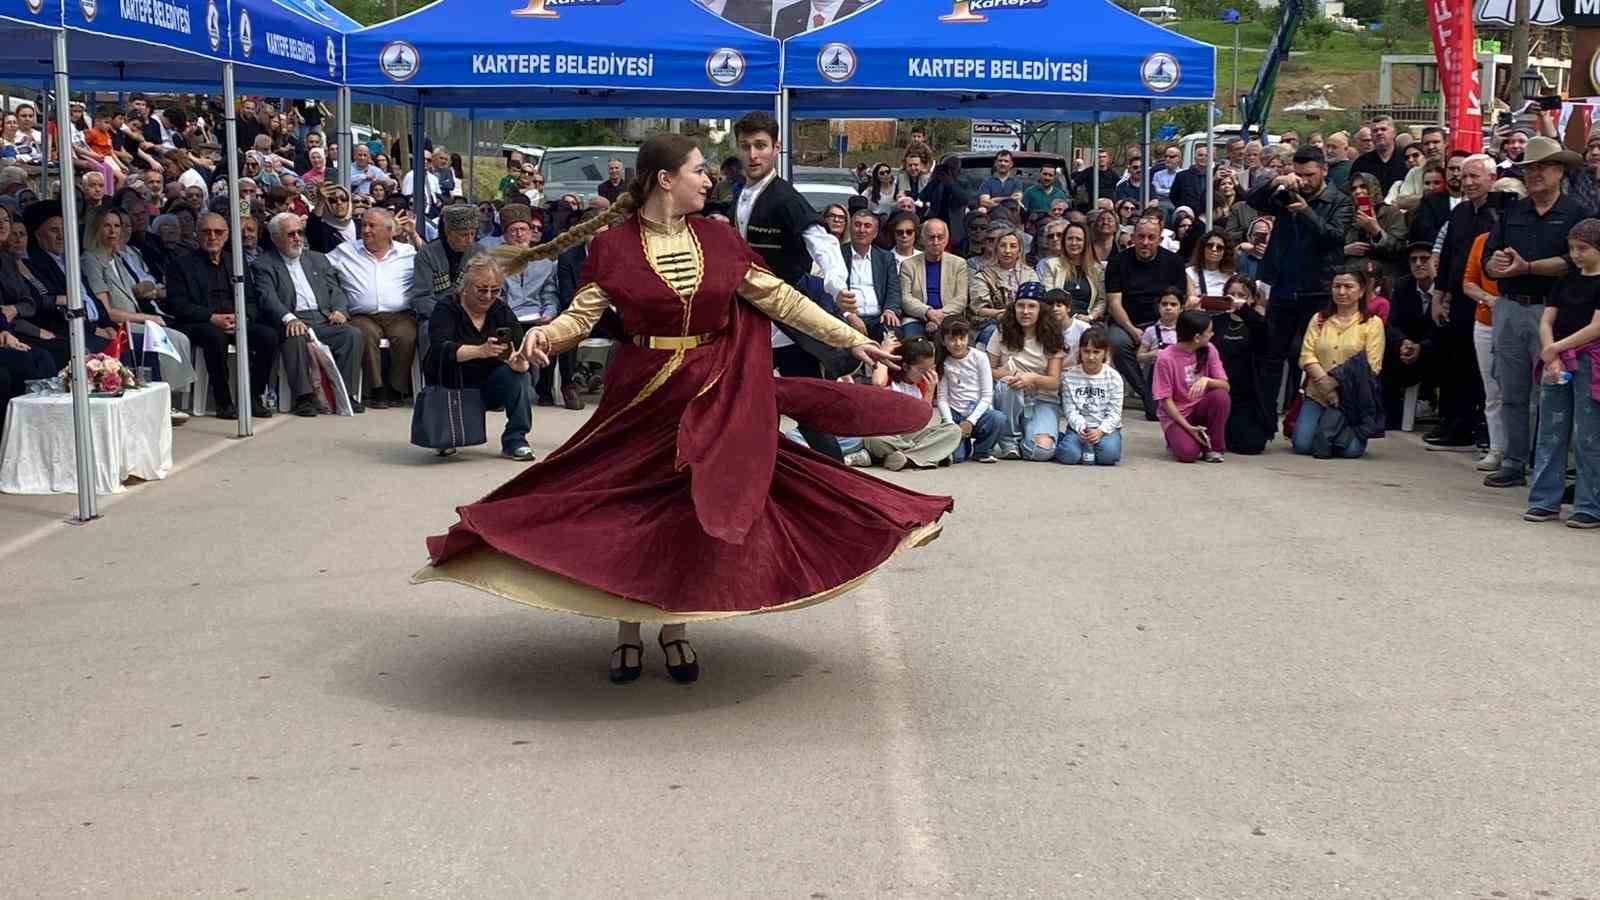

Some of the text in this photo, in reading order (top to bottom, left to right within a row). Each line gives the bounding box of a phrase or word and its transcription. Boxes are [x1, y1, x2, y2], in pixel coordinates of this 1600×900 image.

[472, 53, 654, 77] KARTEPE BELEDİYESİ
[908, 57, 1088, 82] KARTEPE BELEDİYESİ
[1075, 386, 1106, 399] PEANUTS
